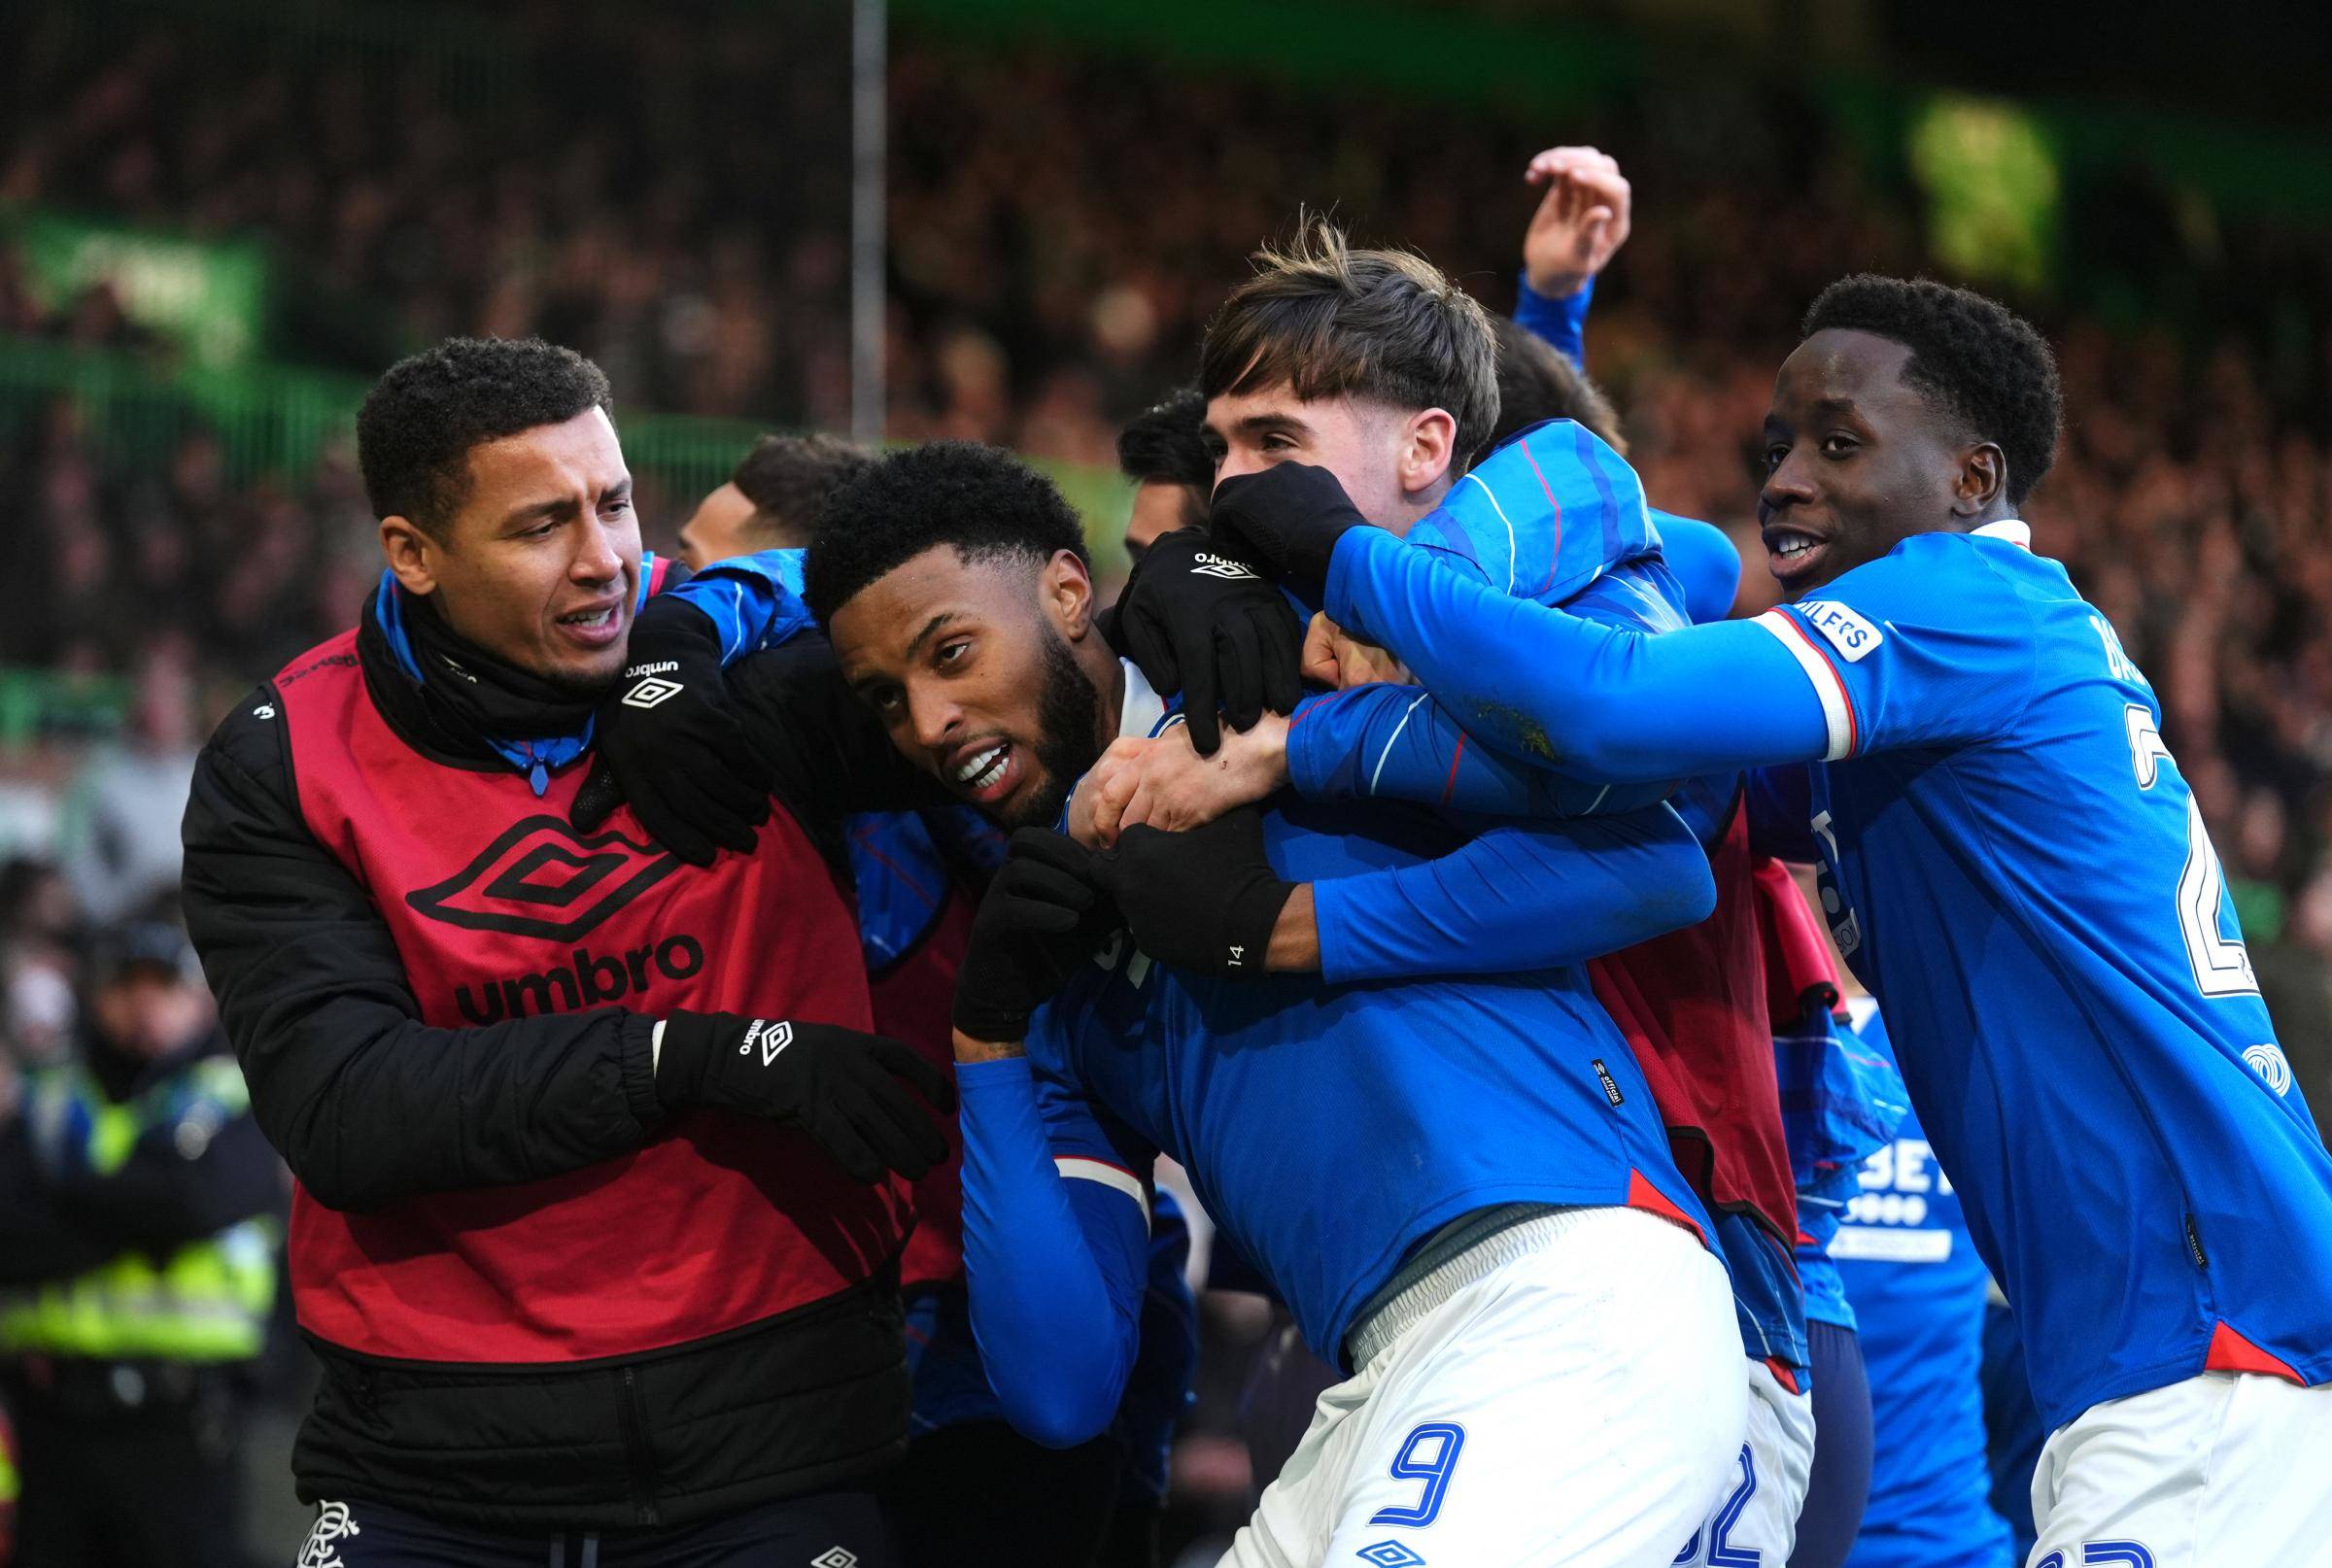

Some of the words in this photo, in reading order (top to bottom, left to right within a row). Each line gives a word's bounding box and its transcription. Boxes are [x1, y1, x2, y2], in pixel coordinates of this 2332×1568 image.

[625, 661, 678, 678] umbro
[1227, 944, 1245, 966] 14
[456, 935, 703, 1024] umbro
[1604, 1075, 1622, 1103] official
[1365, 1420, 1467, 1529] 9
